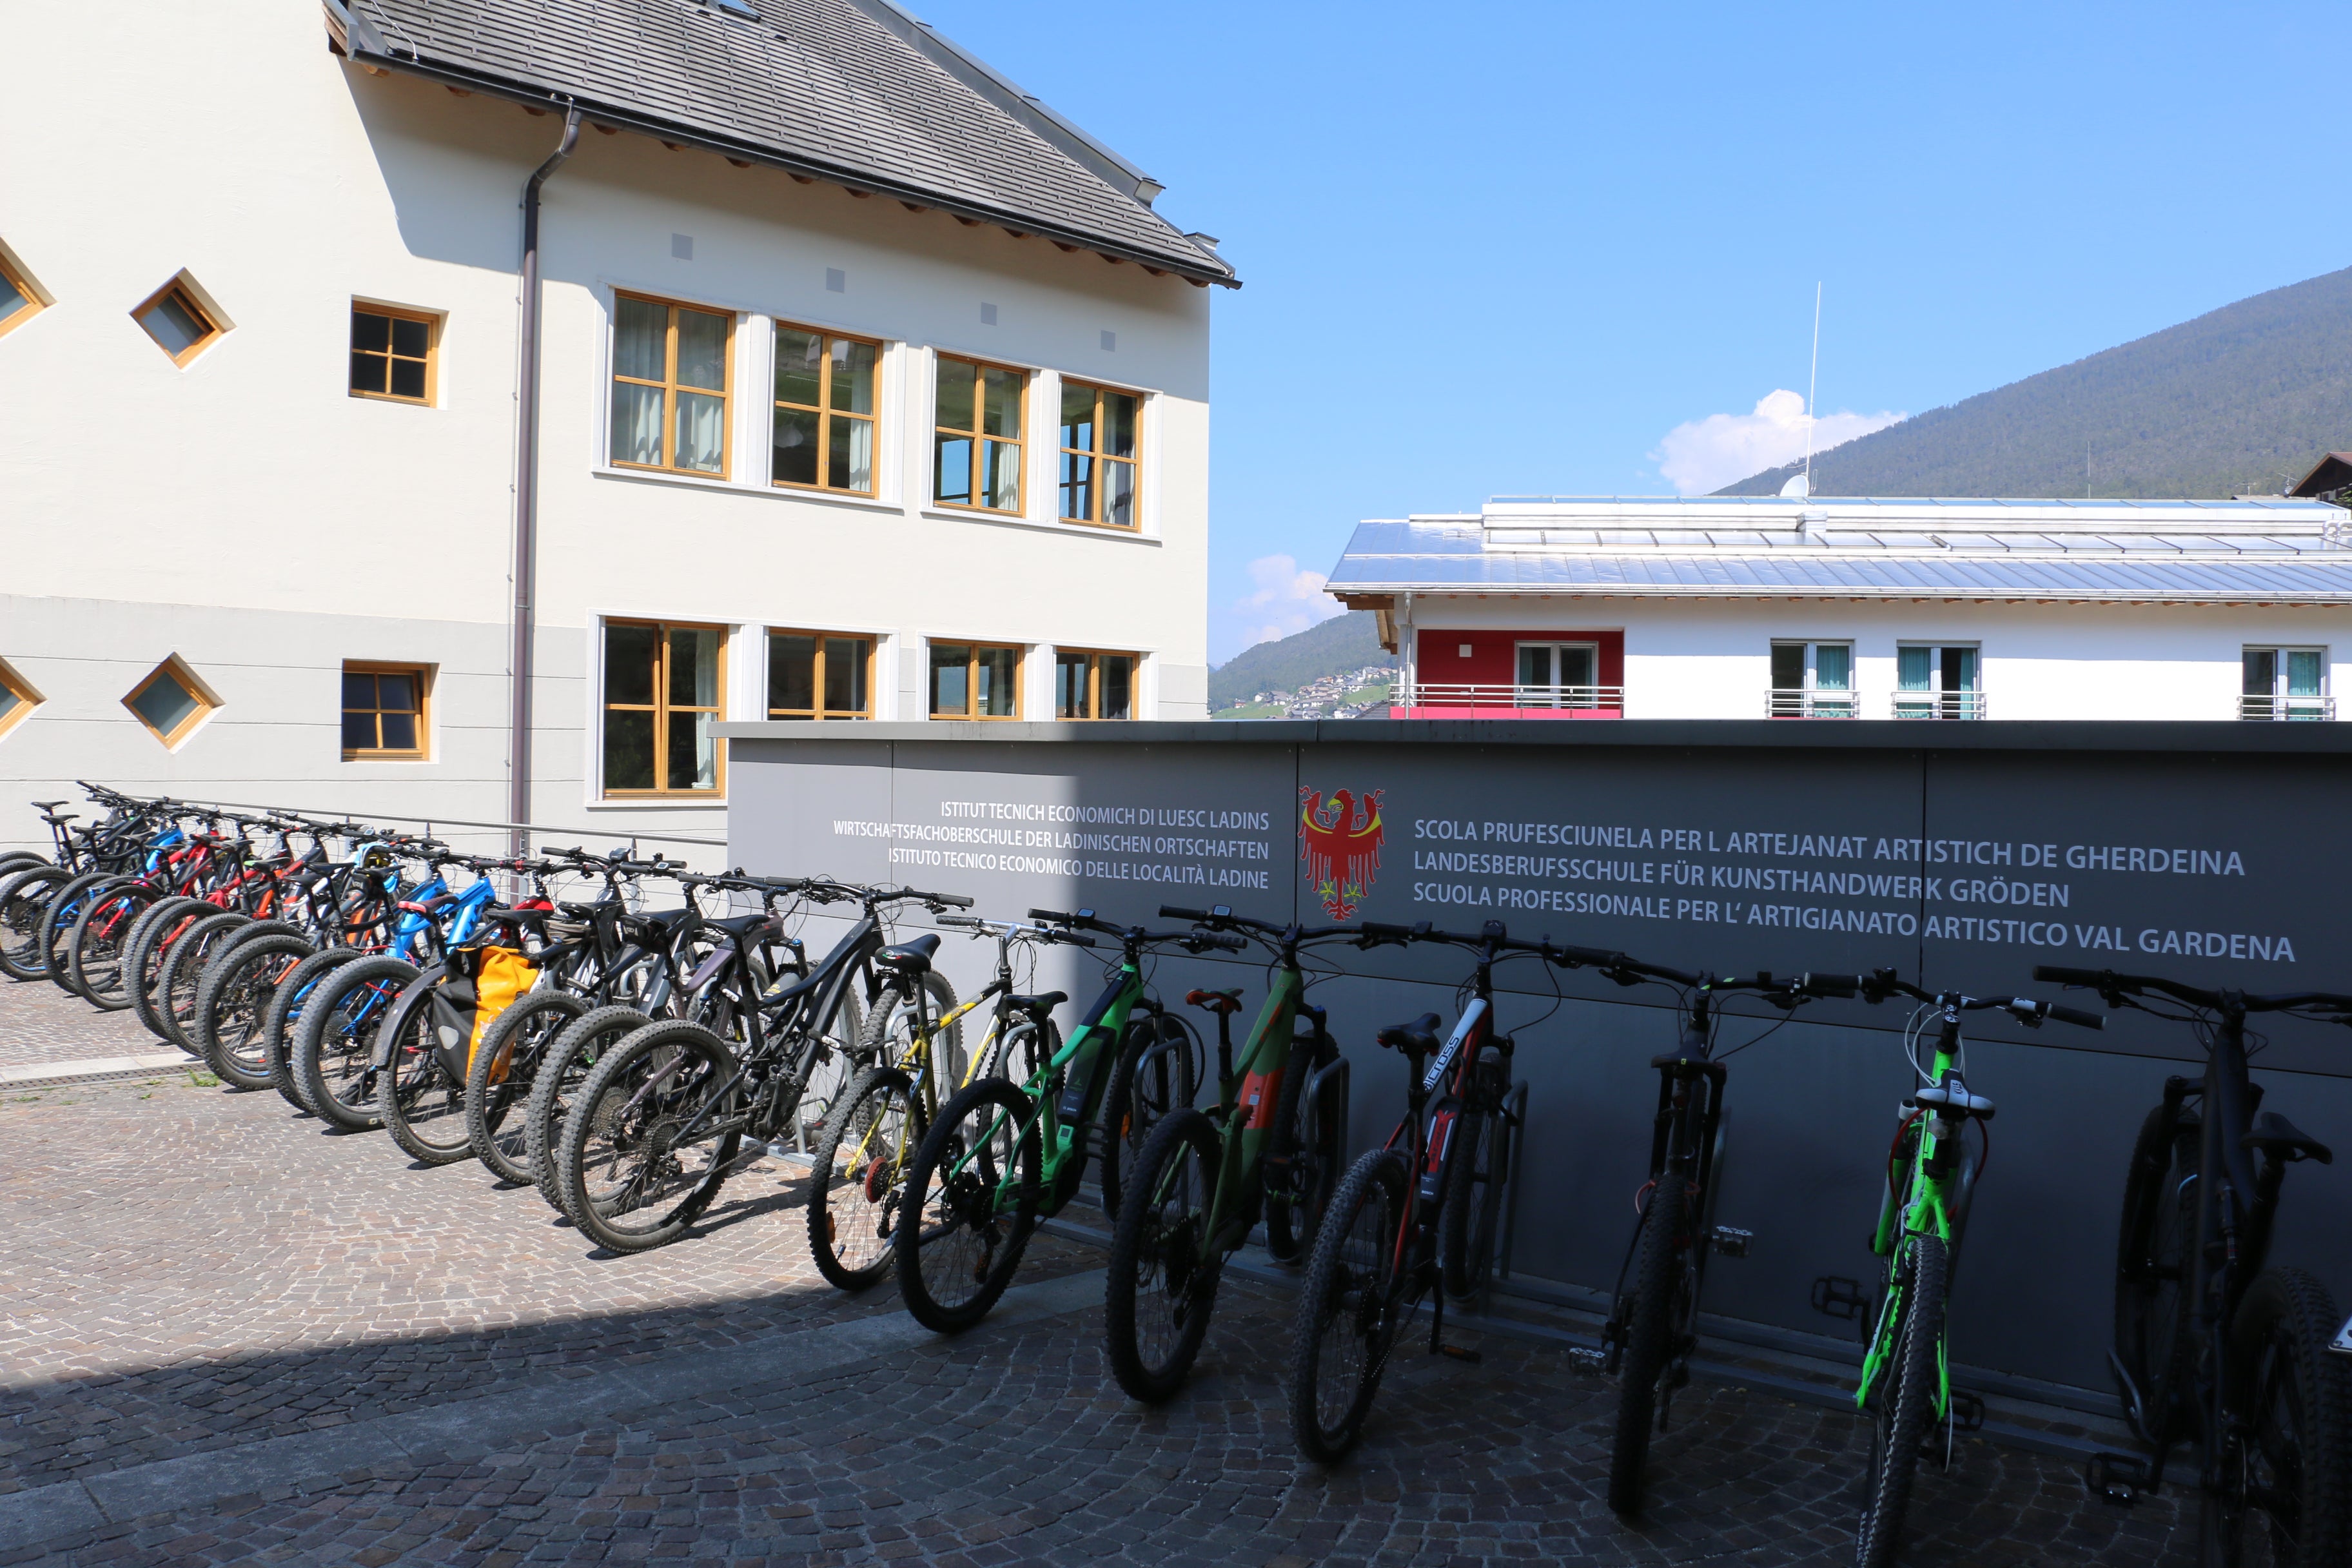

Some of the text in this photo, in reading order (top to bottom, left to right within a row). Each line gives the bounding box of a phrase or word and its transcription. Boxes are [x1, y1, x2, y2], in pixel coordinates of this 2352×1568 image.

[834, 820, 1268, 859] WIRTSCHAFTSFACHOBERSCHULE DER LADINISCHEN ORTSCHAFTEN
[941, 801, 1269, 830] ISTITUT TECNICH ECONOMICH DI LUESC LADINS
[889, 848, 1268, 889] ISTITUTO TECNICO ECONOMICO DELLE LOCALITÀ LADINE
[1415, 819, 2245, 876] SCOLA PRUFESCIUNELA PER L ARTEJANAT ARTISTICH DE GHERDEINA
[1415, 851, 2068, 907] LANDESBERUFSSCHULE FÜR KUNSTHANDWERK GRÖDEN
[1414, 882, 1492, 906] SCUOLA
[1498, 888, 1670, 918] PROFESSIONALE
[1678, 899, 1718, 922] PER
[1747, 904, 1917, 936] ARTIGIANATO
[1924, 916, 2068, 946] ARTISTICO
[2074, 925, 2130, 951] VAL
[2139, 929, 2295, 962] GARDENA
